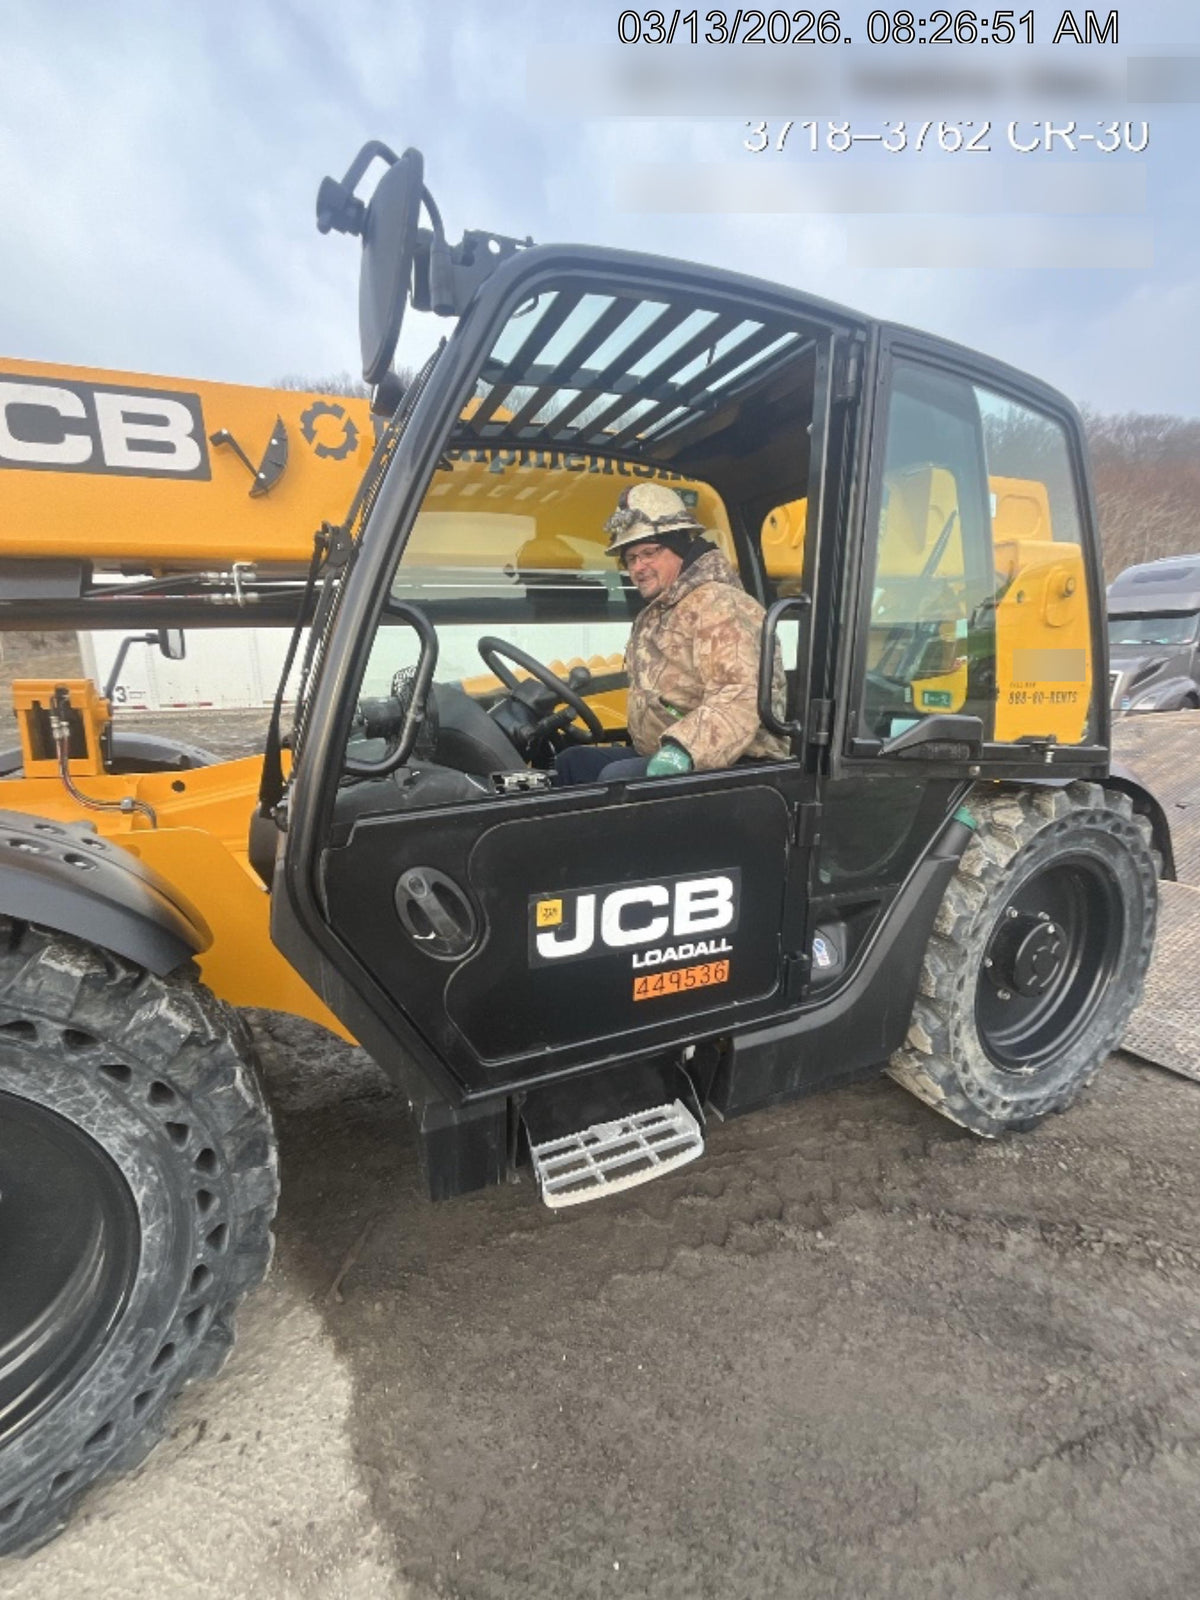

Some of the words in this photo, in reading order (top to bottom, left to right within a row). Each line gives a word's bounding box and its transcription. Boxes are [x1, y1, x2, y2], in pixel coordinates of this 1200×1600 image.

[536, 876, 734, 958] JCB
[632, 938, 733, 969] LOADALL
[635, 963, 727, 996] 449536
